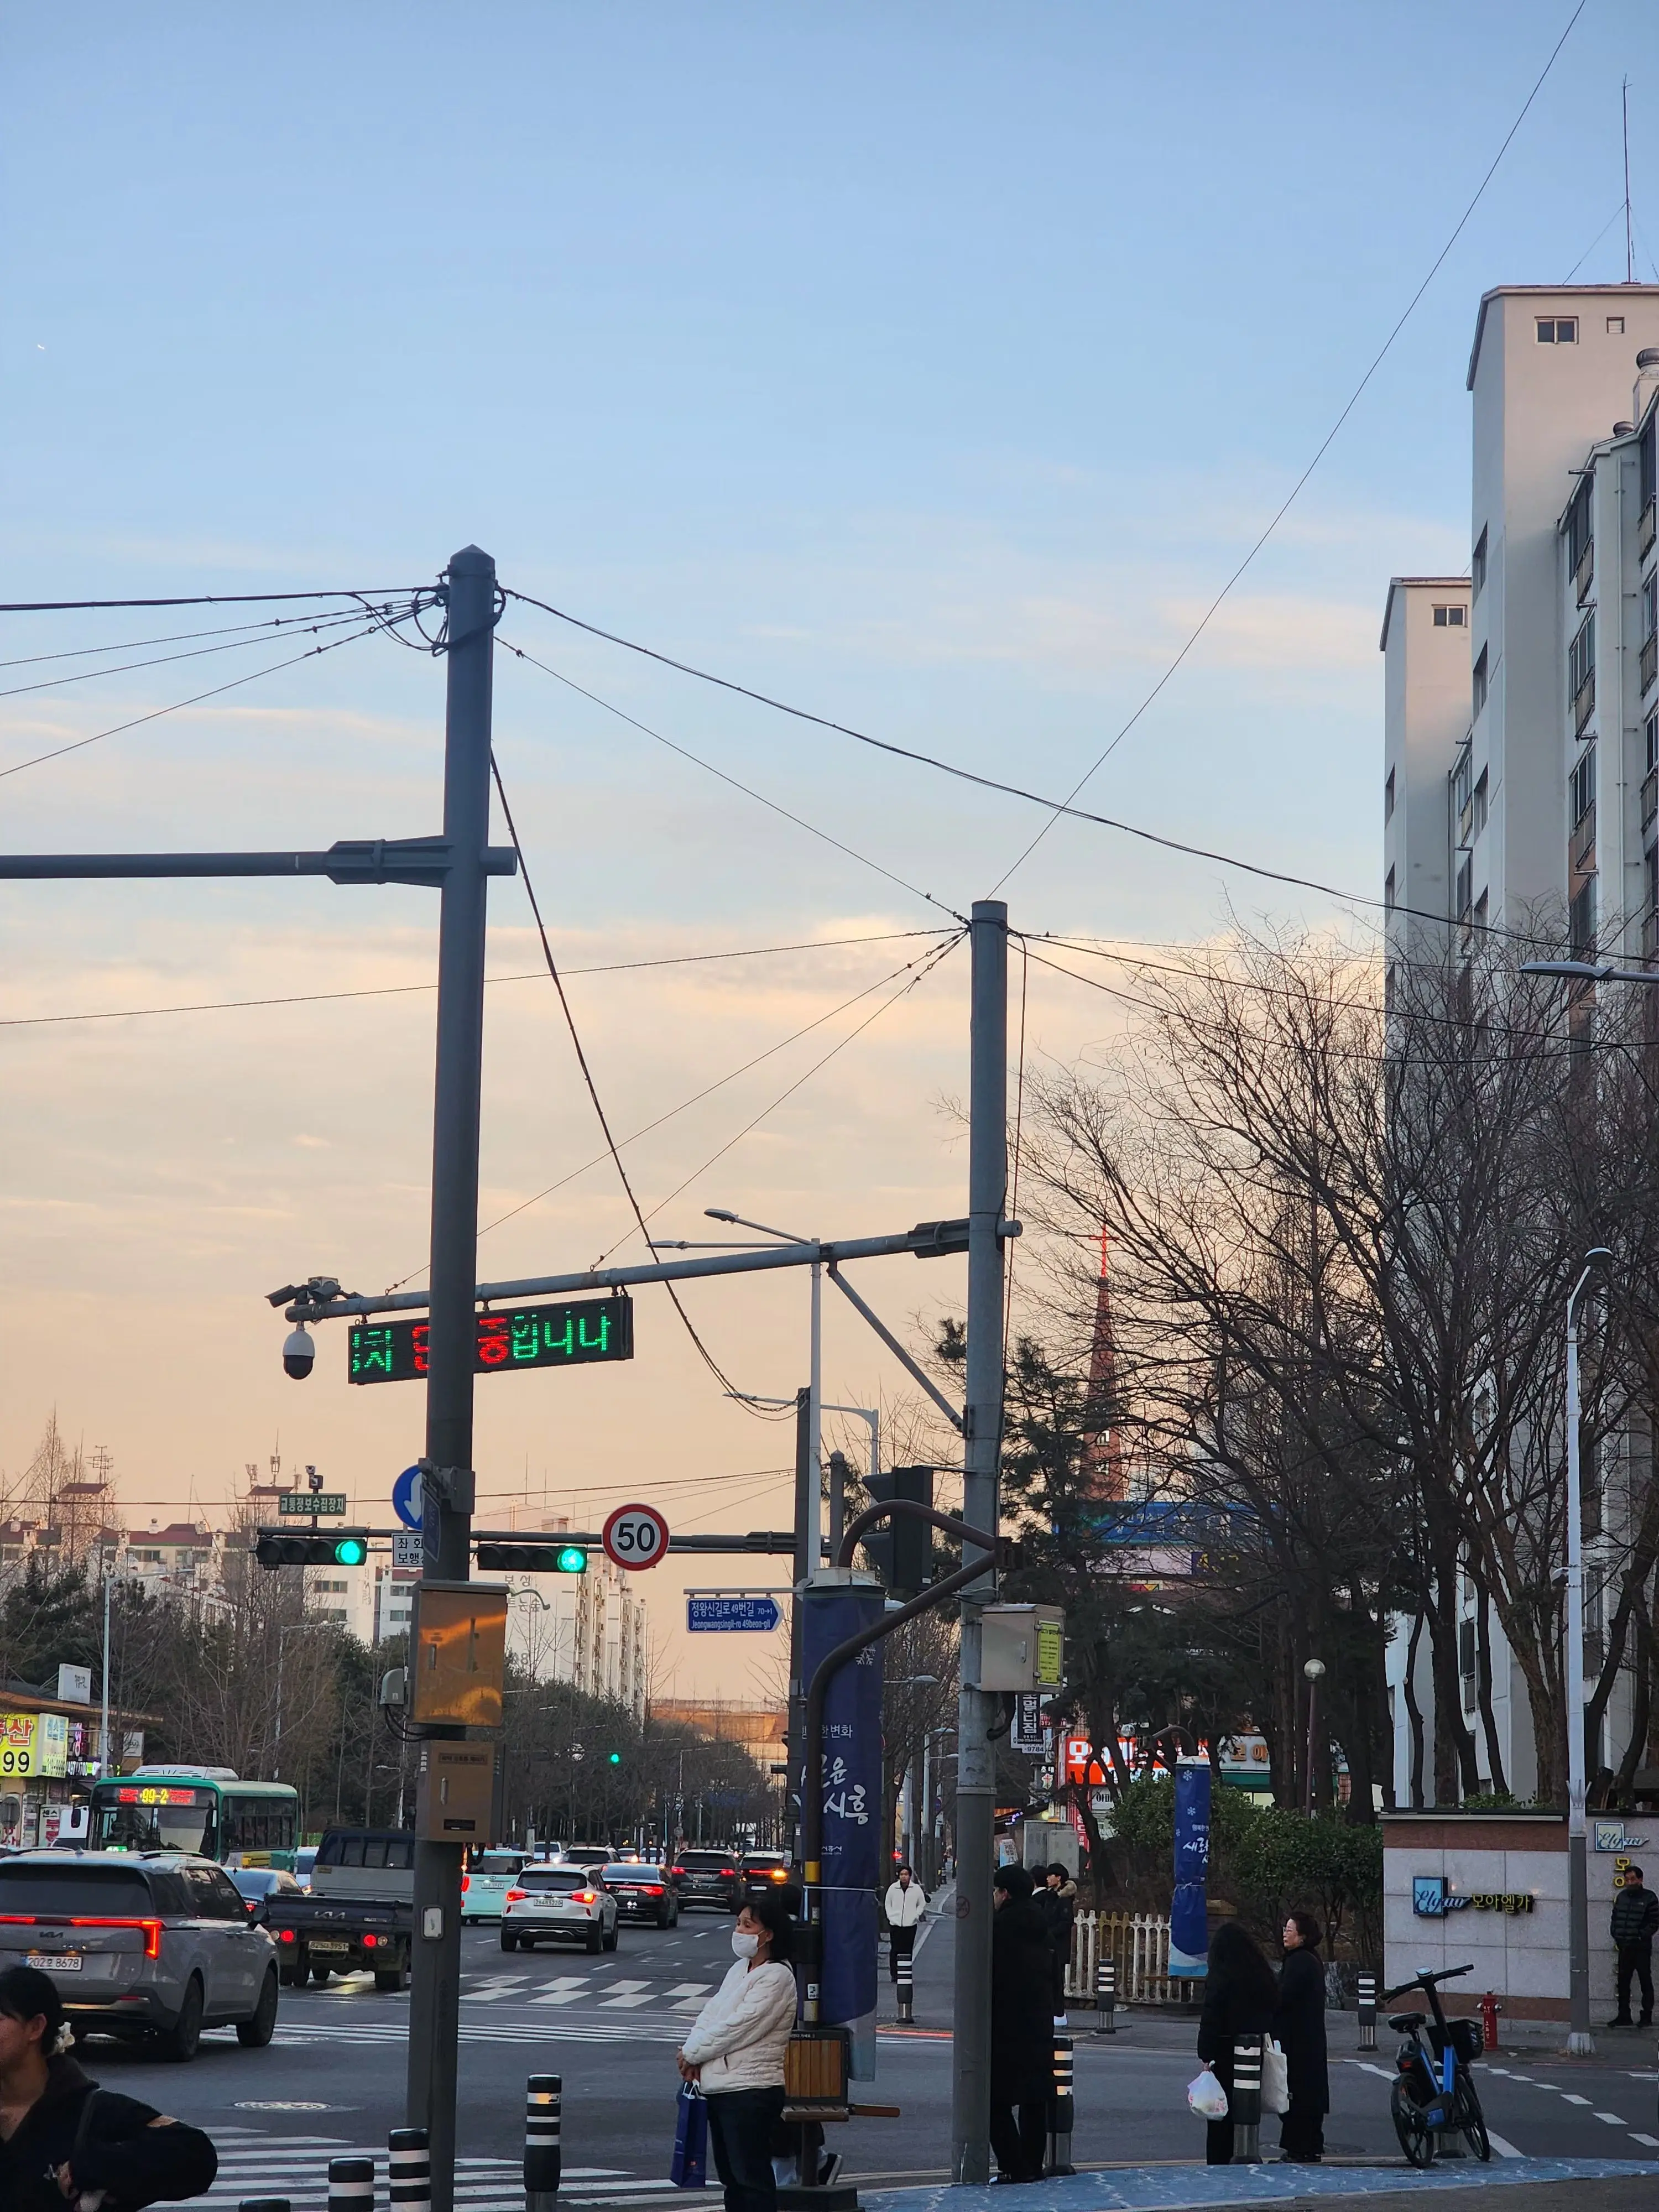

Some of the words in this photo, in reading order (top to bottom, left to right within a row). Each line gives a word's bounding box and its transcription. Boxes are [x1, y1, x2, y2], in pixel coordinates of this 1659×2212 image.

[281, 1497, 343, 1512] 교통정보수집장치
[617, 1522, 655, 1552] 50
[691, 1620, 742, 1630] Jeongwangsingil-ro
[742, 1620, 771, 1630] 49beon-gil
[3, 1751, 30, 1773] 99
[823, 1784, 869, 1825] 시흥
[1473, 1894, 1530, 1913] 모아엘가
[55, 1958, 79, 1969] 8678
